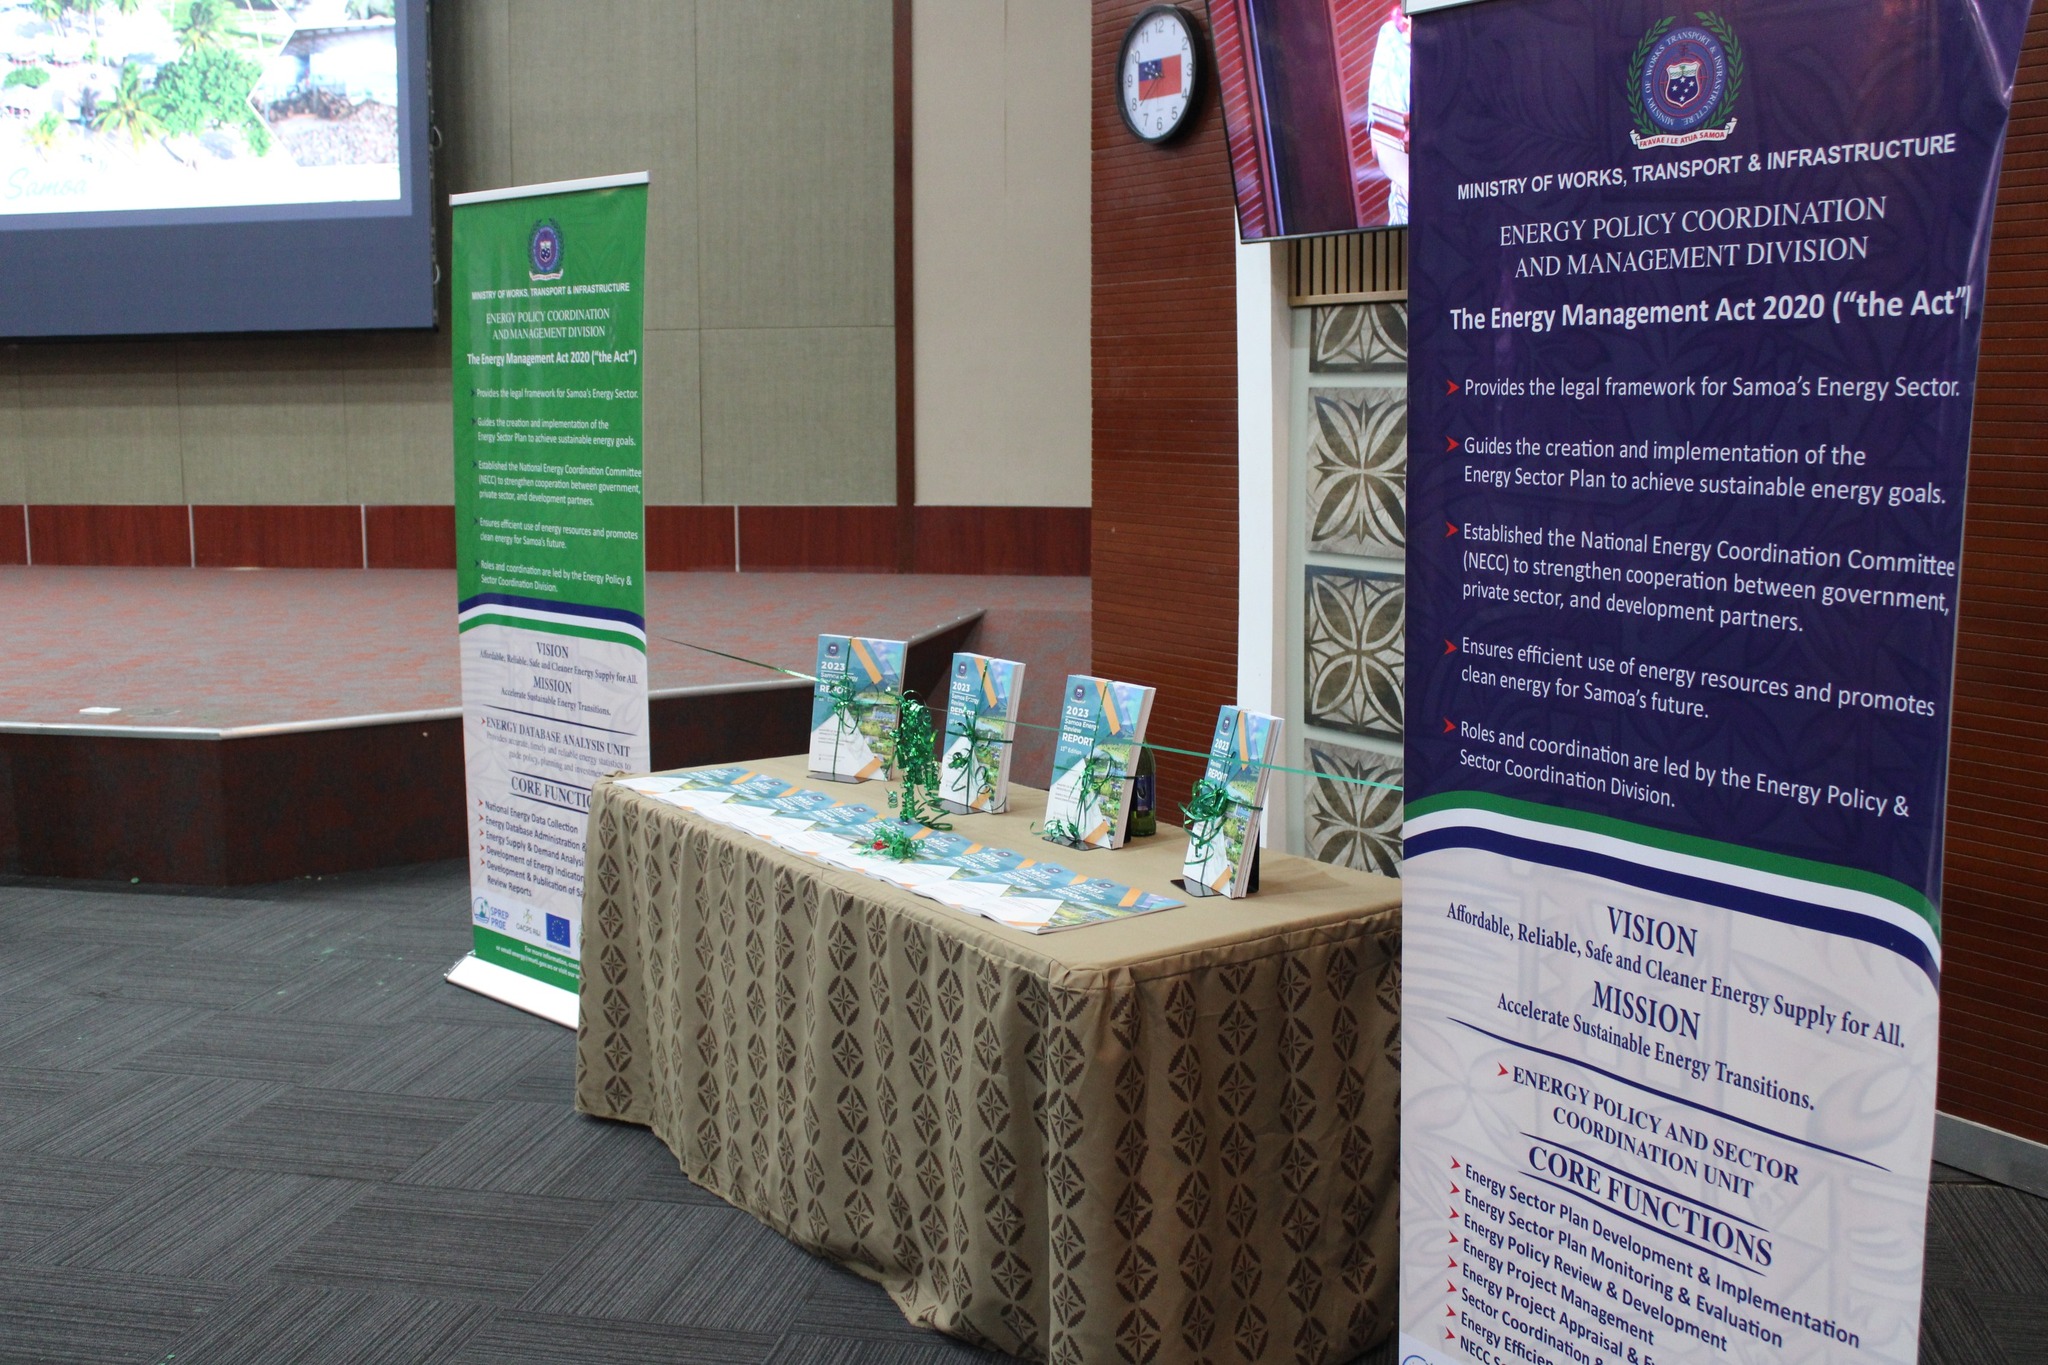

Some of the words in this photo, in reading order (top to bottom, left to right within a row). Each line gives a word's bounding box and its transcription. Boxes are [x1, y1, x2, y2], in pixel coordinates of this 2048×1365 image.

[1141, 31, 1149, 43] 11
[1155, 19, 1164, 33] 12
[1131, 51, 1140, 64] 10
[1458, 177, 1527, 200] MINISTRY
[1531, 174, 1553, 192] OF
[1558, 168, 1626, 189] WORKS,
[1632, 155, 1742, 182] TRANSPORT
[1748, 153, 1761, 171] &
[1767, 133, 1955, 169] INFRASTRUCTURE
[1500, 219, 1586, 246] ENERGY
[1593, 212, 1676, 239] POLICY
[1682, 196, 1886, 232] COORDINATION
[1515, 256, 1560, 277] AND
[1567, 244, 1740, 275] MANAGEMENT
[1746, 236, 1868, 265] DIVISION
[1450, 307, 1485, 329] The
[1491, 307, 1555, 332] Energy
[1562, 300, 1708, 329] Management
[1715, 298, 1756, 321] Act
[1762, 293, 1824, 319] 2020
[1833, 290, 1903, 323] (“the
[467, 353, 480, 364] The
[481, 353, 504, 366] Energy
[506, 353, 554, 366] Management
[556, 352, 568, 363] Act
[570, 351, 590, 363] 2020
[591, 350, 612, 365] (“the
[613, 349, 636, 364] Act”)
[1465, 377, 1524, 395] Provides
[1529, 377, 1555, 395] the
[1561, 377, 1599, 399] legal
[1605, 376, 1695, 395] framework
[1701, 376, 1727, 395] for
[1732, 375, 1810, 396] Samoa’s
[1818, 377, 1889, 401] Energy
[1894, 376, 1959, 396] Sector.
[1464, 436, 1511, 454] Guides
[1516, 437, 1540, 455] the
[1546, 439, 1614, 457] creation
[1620, 440, 1648, 458] and
[1654, 441, 1798, 464] implementation
[1805, 444, 1826, 464] of
[1831, 444, 1866, 465] the
[1465, 465, 1510, 487] Energy
[1514, 467, 1564, 486] Sector
[1570, 469, 1605, 487] Plan
[1610, 472, 1626, 488] to
[1631, 471, 1694, 492] achieve
[1699, 476, 1805, 497] sustainable
[1811, 483, 1883, 505] energy
[1888, 482, 1945, 506] goals.
[1464, 523, 1542, 545] Established
[1548, 528, 1575, 547] the
[1581, 530, 1647, 552] National
[1653, 536, 1711, 562] Energy
[1717, 540, 1840, 567] Coordination
[1848, 549, 1955, 576] Committee
[1464, 550, 1508, 575] (NECC)
[1513, 557, 1528, 573] to
[1533, 559, 1621, 582] strengthen
[1626, 569, 1726, 591] cooperation
[1734, 573, 1815, 599] between
[1822, 586, 1949, 616] government,
[1463, 581, 1509, 600] private
[1513, 589, 1563, 609] sector,
[1570, 591, 1600, 609] and
[1606, 593, 1714, 622] development
[1720, 609, 1802, 631] partners.
[536, 641, 568, 658] VISION
[821, 661, 846, 671] 2023
[533, 675, 571, 693] MISSION
[952, 681, 970, 692] 2023
[1066, 705, 1089, 718] 2023
[486, 716, 516, 733] ENERGY
[519, 724, 560, 743] DATABASE
[563, 734, 604, 752] ANALYSIS
[606, 742, 630, 757] UNIT
[1062, 733, 1094, 747] REPORT
[1214, 738, 1230, 751] 2023
[511, 776, 541, 796] CORE
[485, 800, 509, 815] National
[510, 807, 530, 822] Energy
[531, 813, 546, 825] Data
[547, 817, 578, 833] Collection
[1607, 905, 1698, 957] VISION
[1446, 902, 1513, 941] Affordable,
[1518, 923, 1581, 957] Reliable,
[1585, 940, 1612, 964] Safe
[1616, 955, 1641, 974] and
[1646, 959, 1707, 992] Cleaner
[1710, 976, 1770, 1013] Energy
[1774, 994, 1836, 1031] Supply
[1841, 1011, 1870, 1037] for
[1873, 1021, 1904, 1048] All.
[1592, 980, 1700, 1040] MISSION
[1497, 993, 1569, 1028] Accelerate
[1573, 1014, 1650, 1057] Sustainable
[1654, 1042, 1710, 1078] Energy
[1715, 1060, 1814, 1110] Transitions.
[1513, 1066, 1589, 1105] ENERGY
[1594, 1093, 1661, 1134] POLICY
[1665, 1123, 1708, 1150] AND
[1713, 1138, 1798, 1185] SECTOR
[1553, 1107, 1697, 1177] COORDINATION
[1704, 1164, 1754, 1198] UNIT
[1529, 1146, 1600, 1195] CORE
[1607, 1176, 1772, 1266] FUNCTIONS
